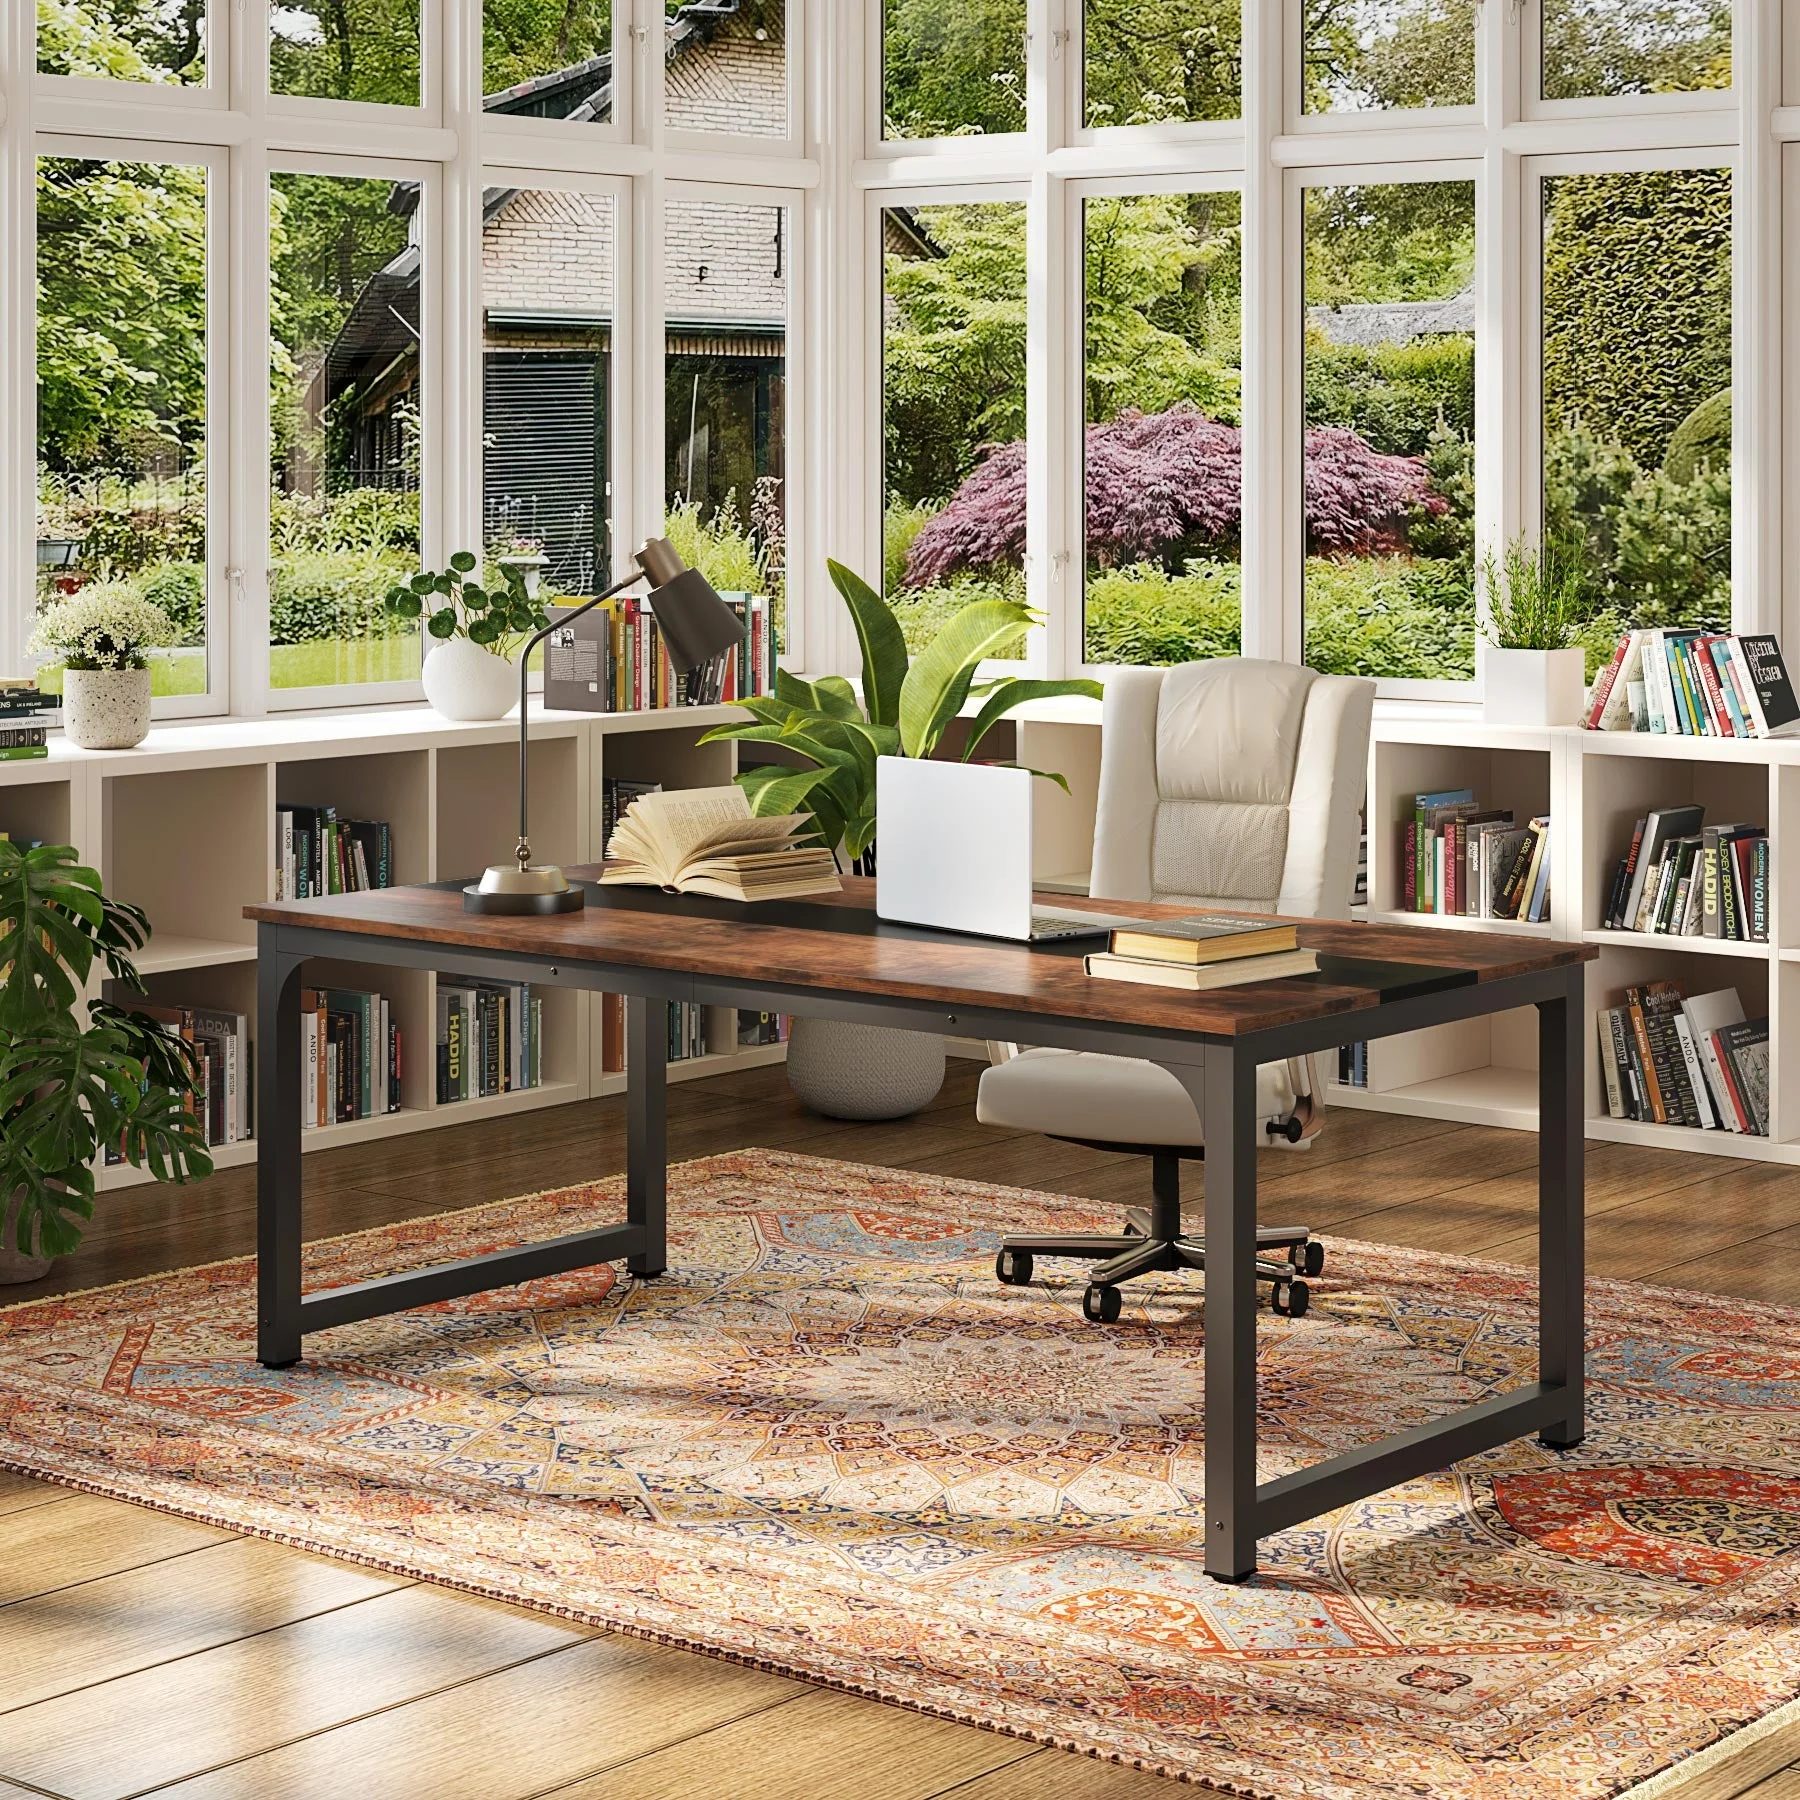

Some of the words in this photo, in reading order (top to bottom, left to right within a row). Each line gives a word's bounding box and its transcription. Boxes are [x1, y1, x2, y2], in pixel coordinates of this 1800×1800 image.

[1703, 663, 1724, 712] ANTIQUAIRES
[1406, 824, 1415, 852] Parr
[1445, 826, 1455, 855] Parr
[1521, 837, 1531, 854] COOL
[1512, 856, 1525, 874] GUIDE
[1720, 837, 1730, 872] ALEXEY
[1757, 843, 1765, 875] MODERN
[1406, 855, 1414, 897] Martin
[1445, 858, 1455, 901] Martin
[1503, 872, 1516, 896] London
[1705, 848, 1716, 915] HADID
[1723, 872, 1736, 932] BRODOVITCH
[1754, 876, 1765, 932] WOMEN
[1646, 994, 1660, 1007] Cool
[1660, 990, 1680, 1003] Hotels
[450, 1015, 459, 1079] HADID
[1637, 1032, 1646, 1054] Hotels
[1682, 1036, 1694, 1064] ANDO
